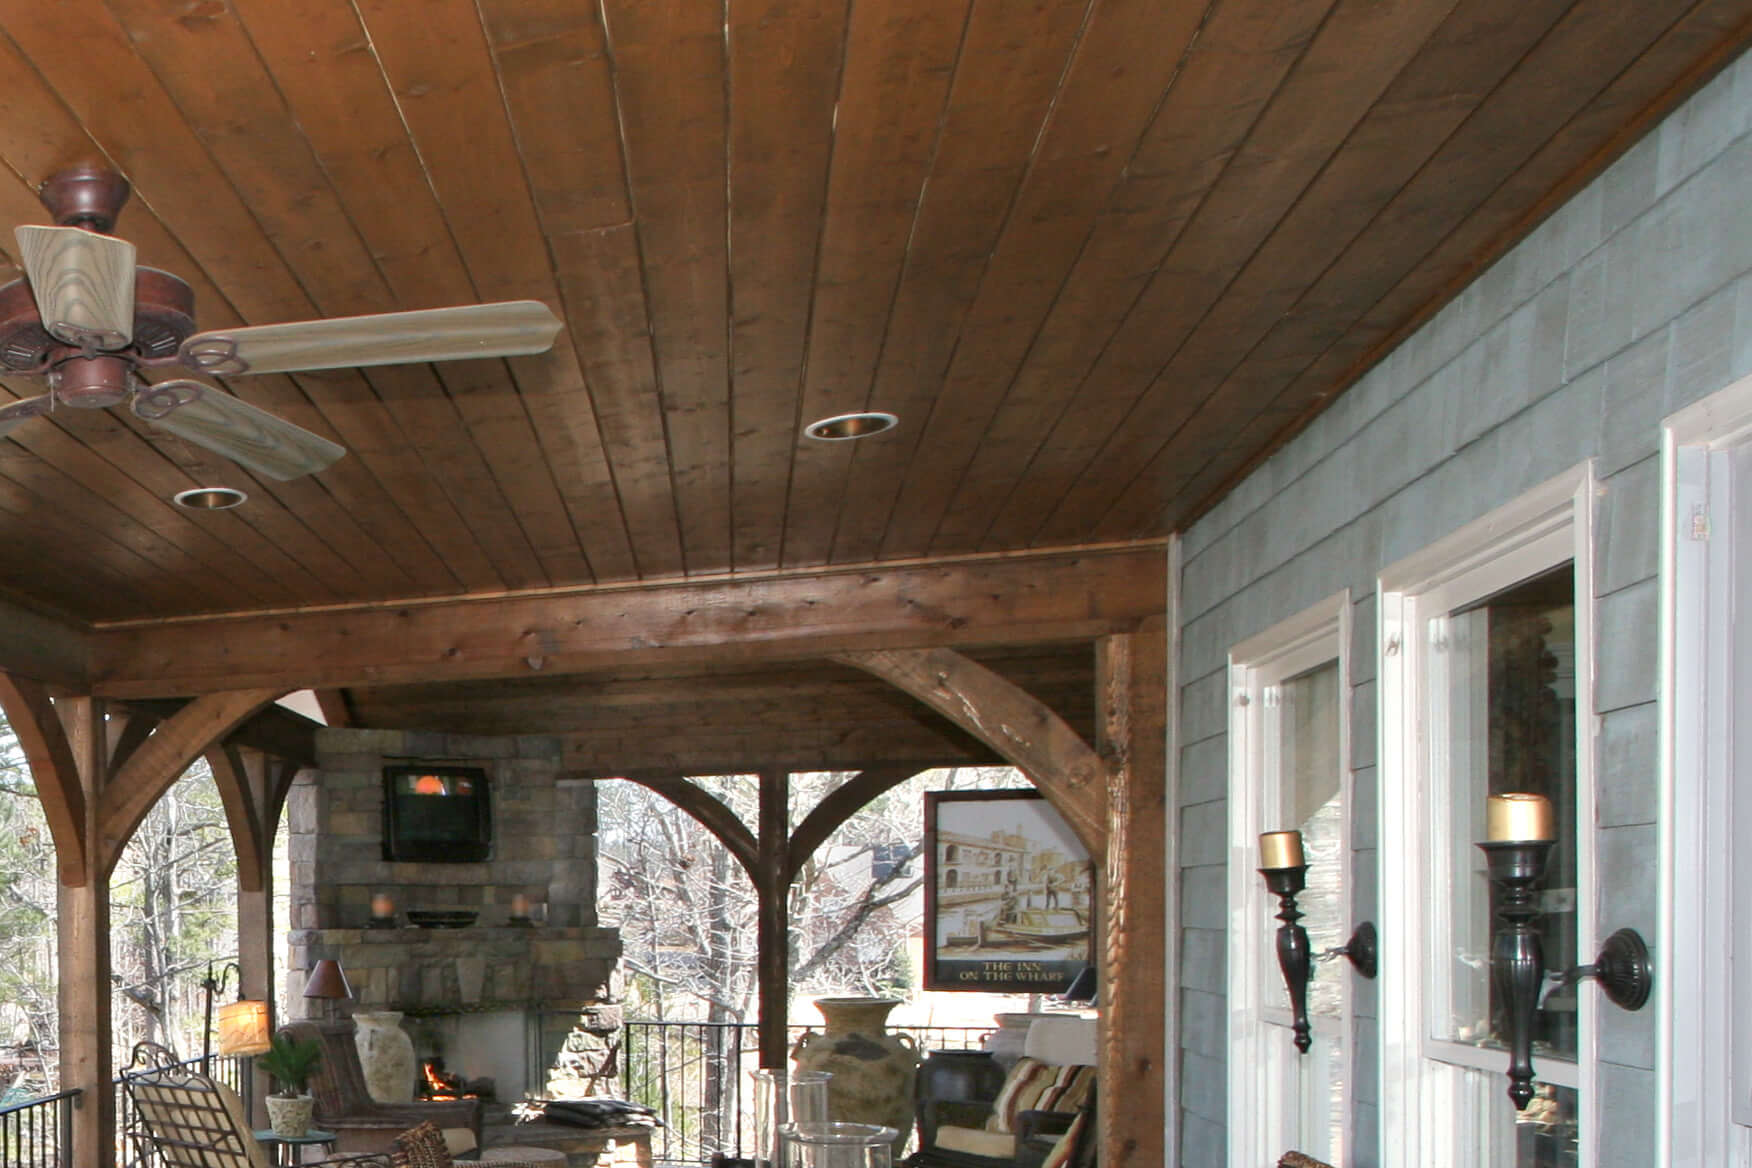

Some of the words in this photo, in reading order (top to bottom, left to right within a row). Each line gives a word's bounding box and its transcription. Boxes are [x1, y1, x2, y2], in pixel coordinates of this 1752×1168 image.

[983, 961, 1012, 971] THE
[1017, 961, 1041, 971] INN
[959, 971, 978, 981] ON
[983, 971, 1012, 981] THE
[1016, 971, 1064, 982] WHARF
